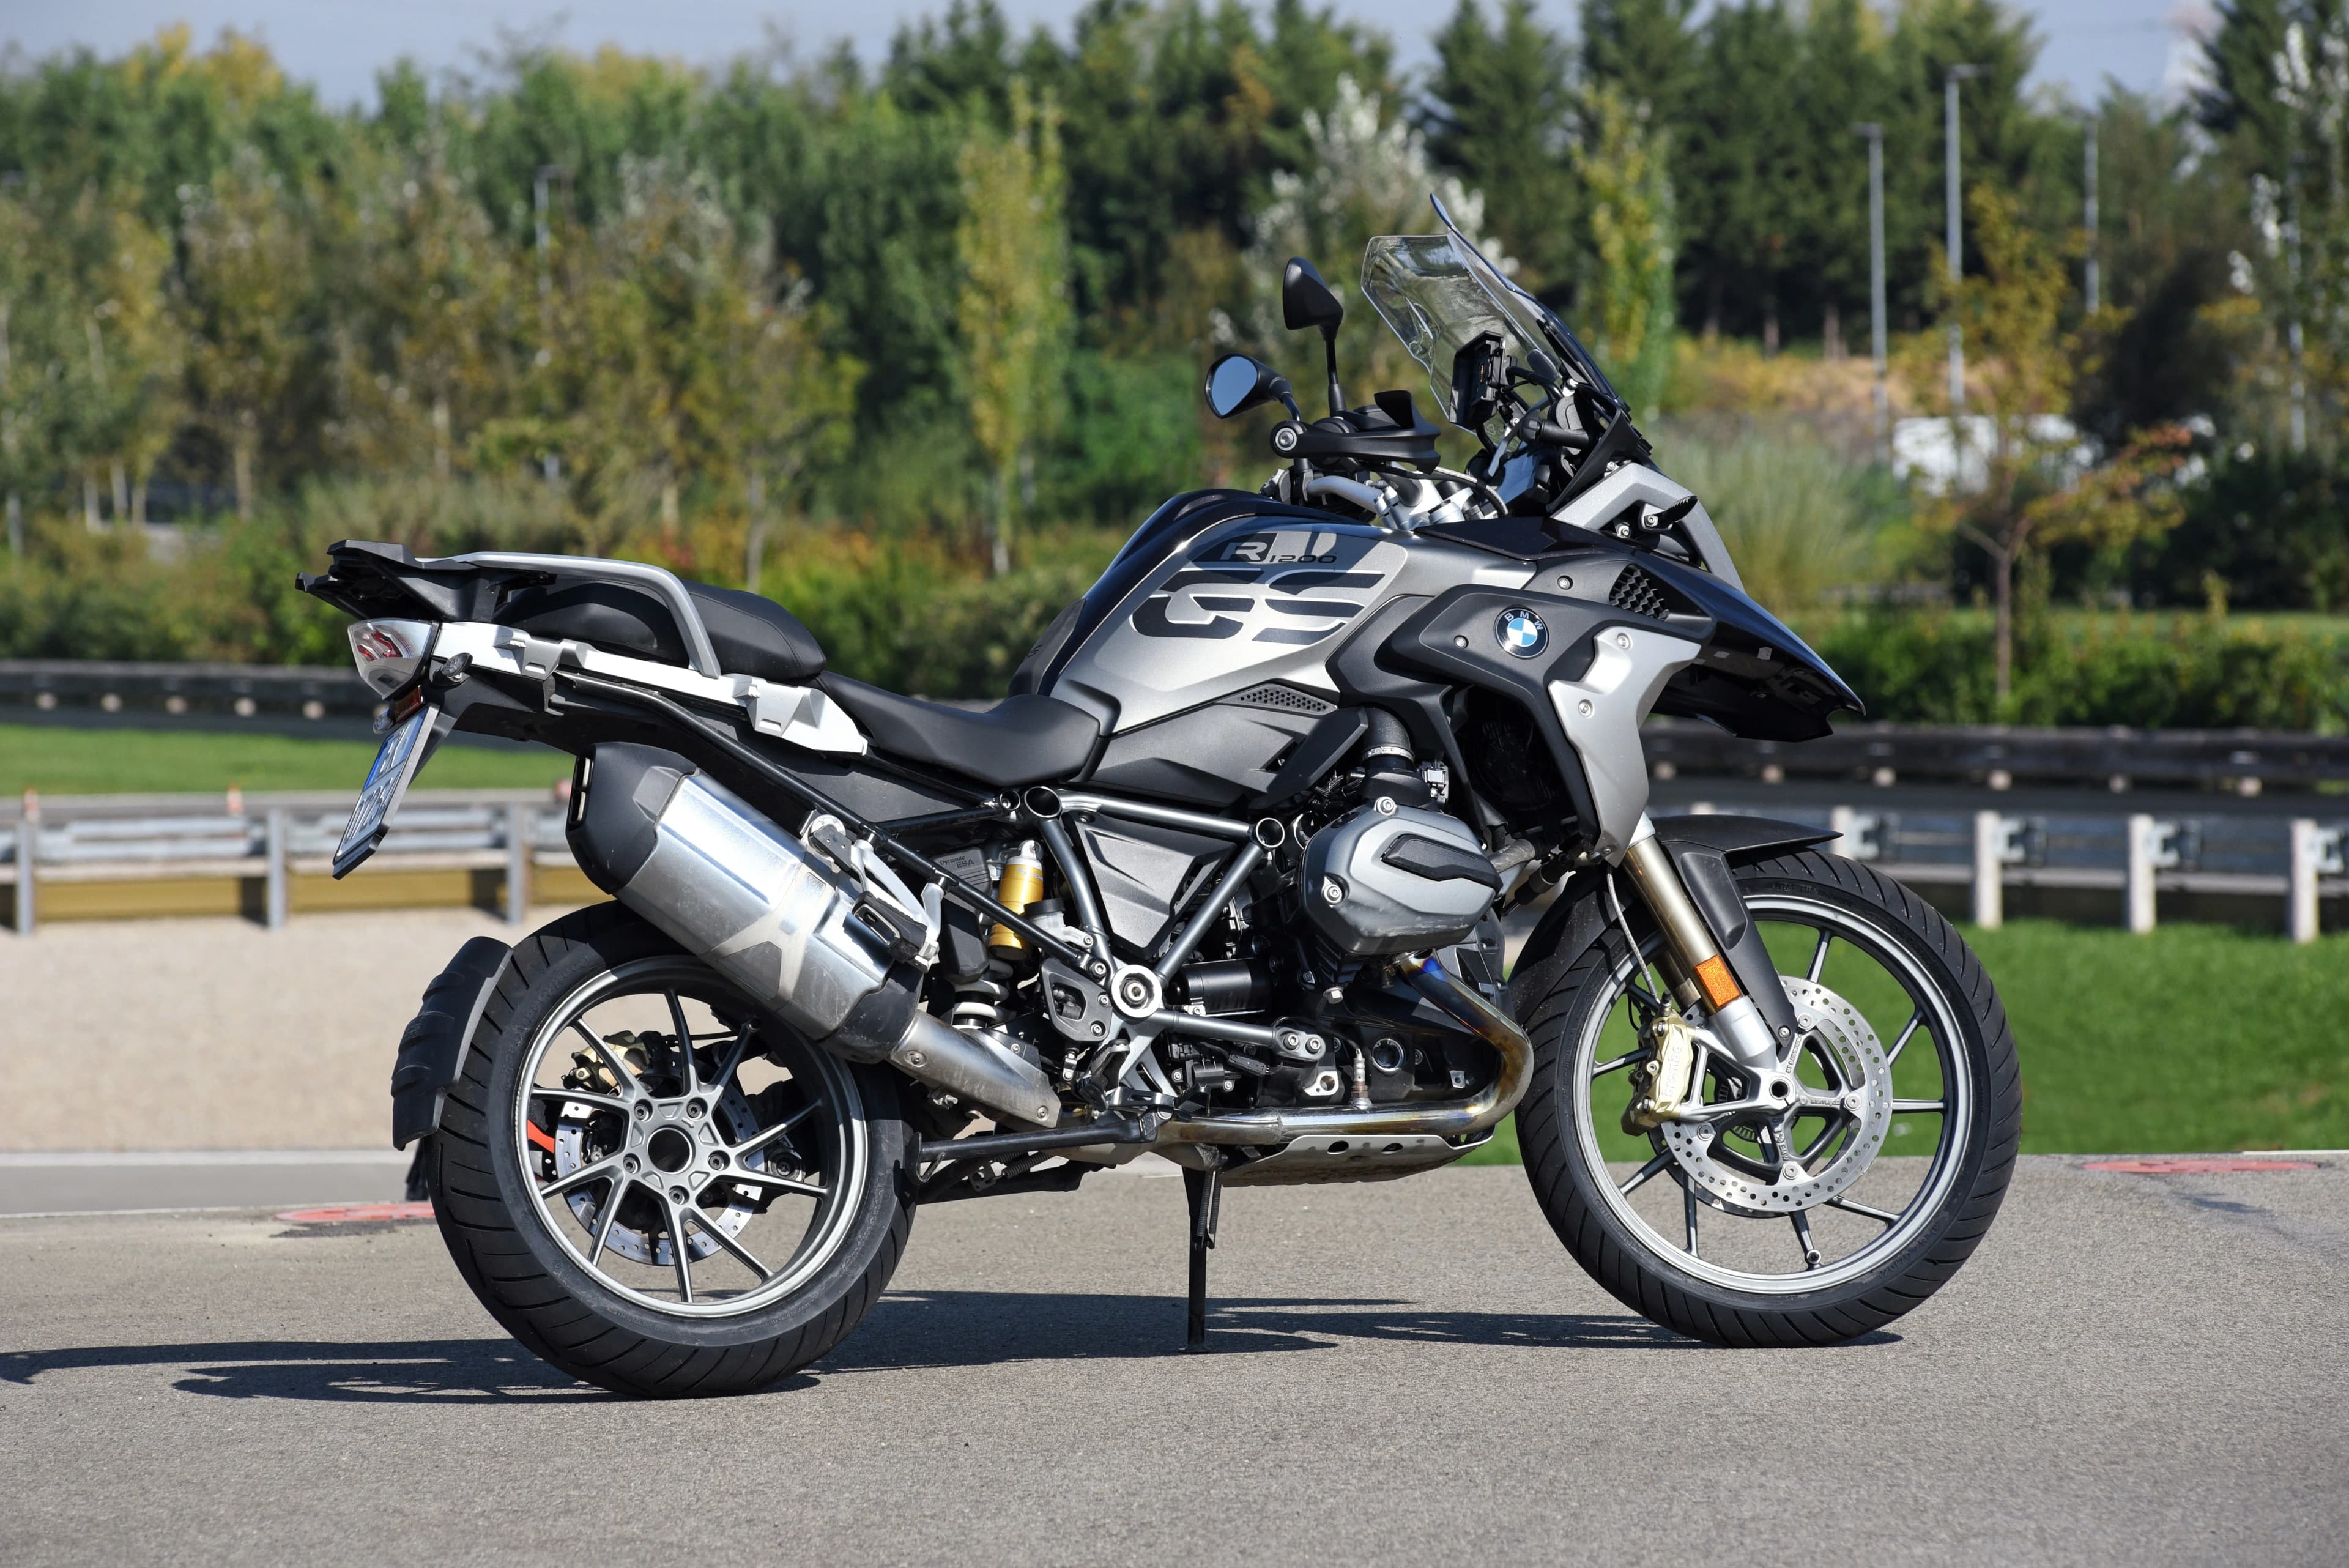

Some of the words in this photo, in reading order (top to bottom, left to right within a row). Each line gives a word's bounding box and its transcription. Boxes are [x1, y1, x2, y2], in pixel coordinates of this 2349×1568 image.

[1129, 567, 1386, 645] GS
[1504, 611, 1544, 631] BMW
[940, 855, 966, 866] Dynamic
[956, 859, 974, 869] ESA
[1661, 1046, 1682, 1098] brembo
